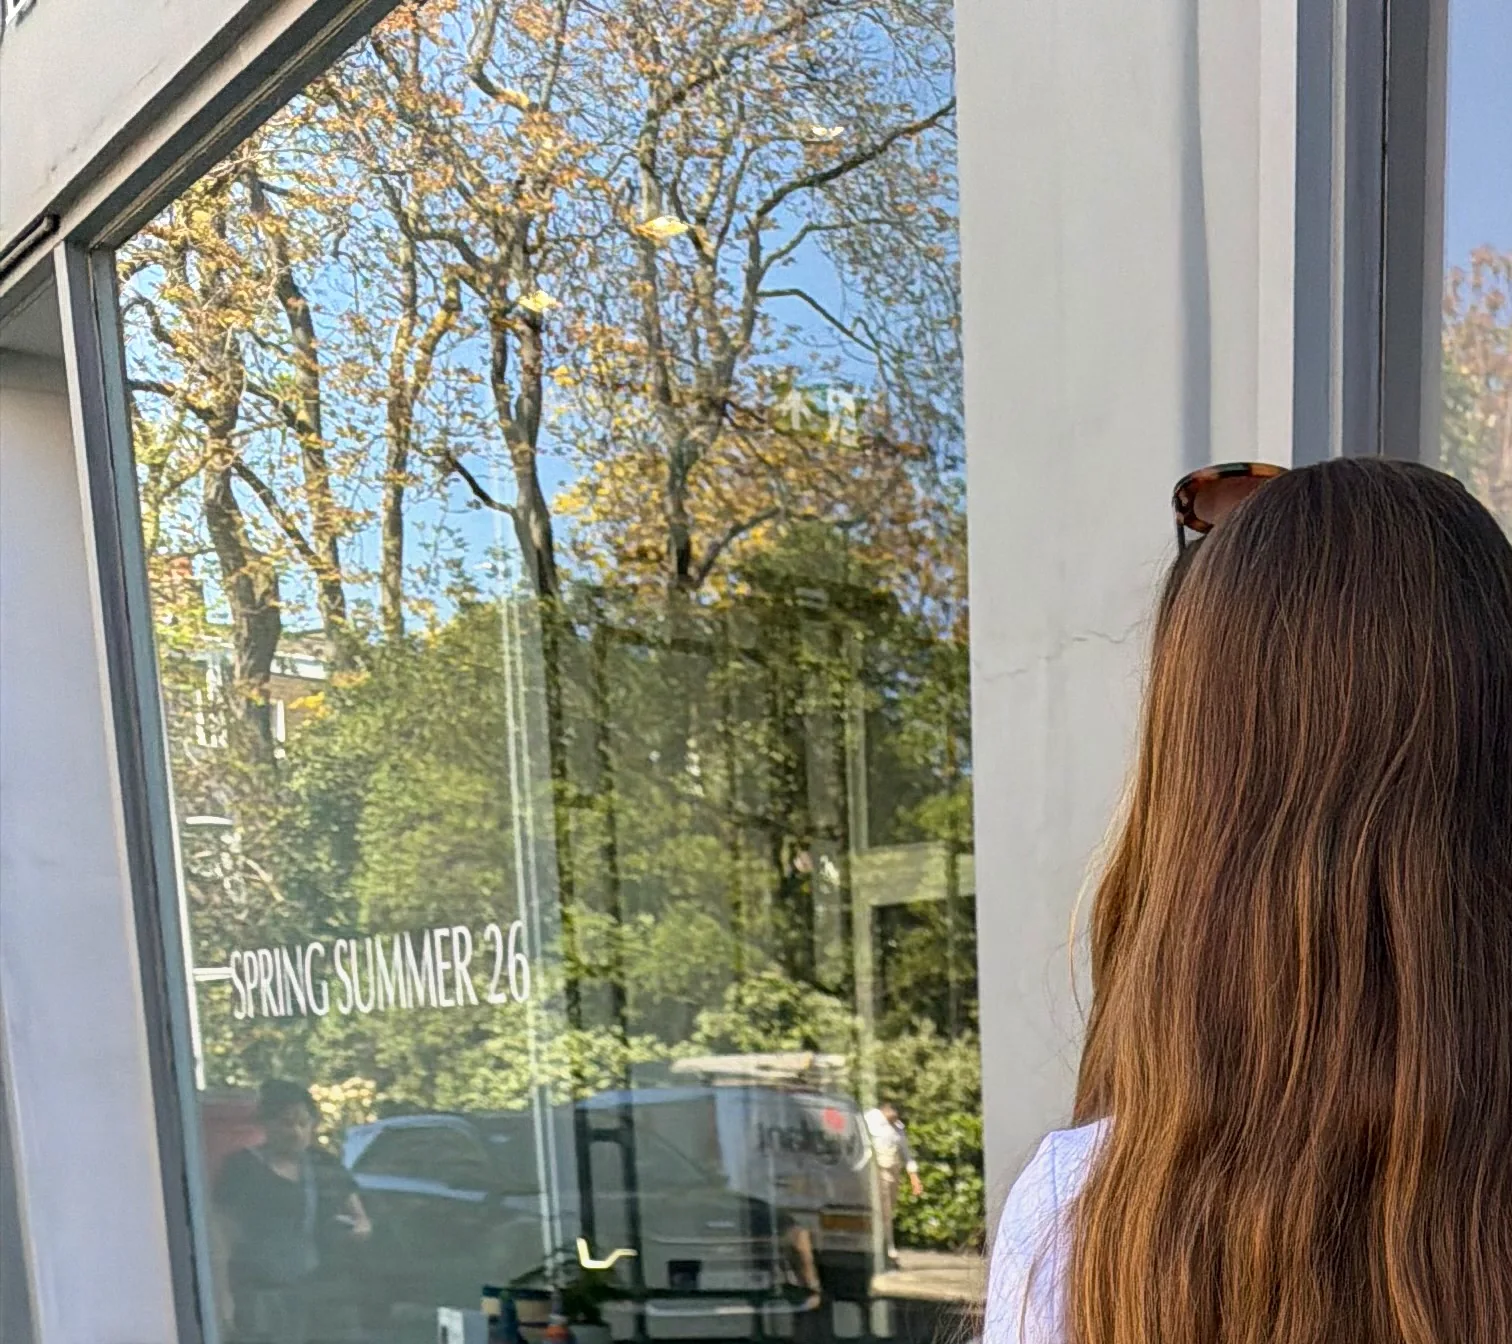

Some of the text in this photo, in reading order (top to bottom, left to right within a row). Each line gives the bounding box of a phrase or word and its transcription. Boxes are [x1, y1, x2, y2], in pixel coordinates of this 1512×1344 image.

[230, 919, 531, 1020] SPRING SUMMER 26
